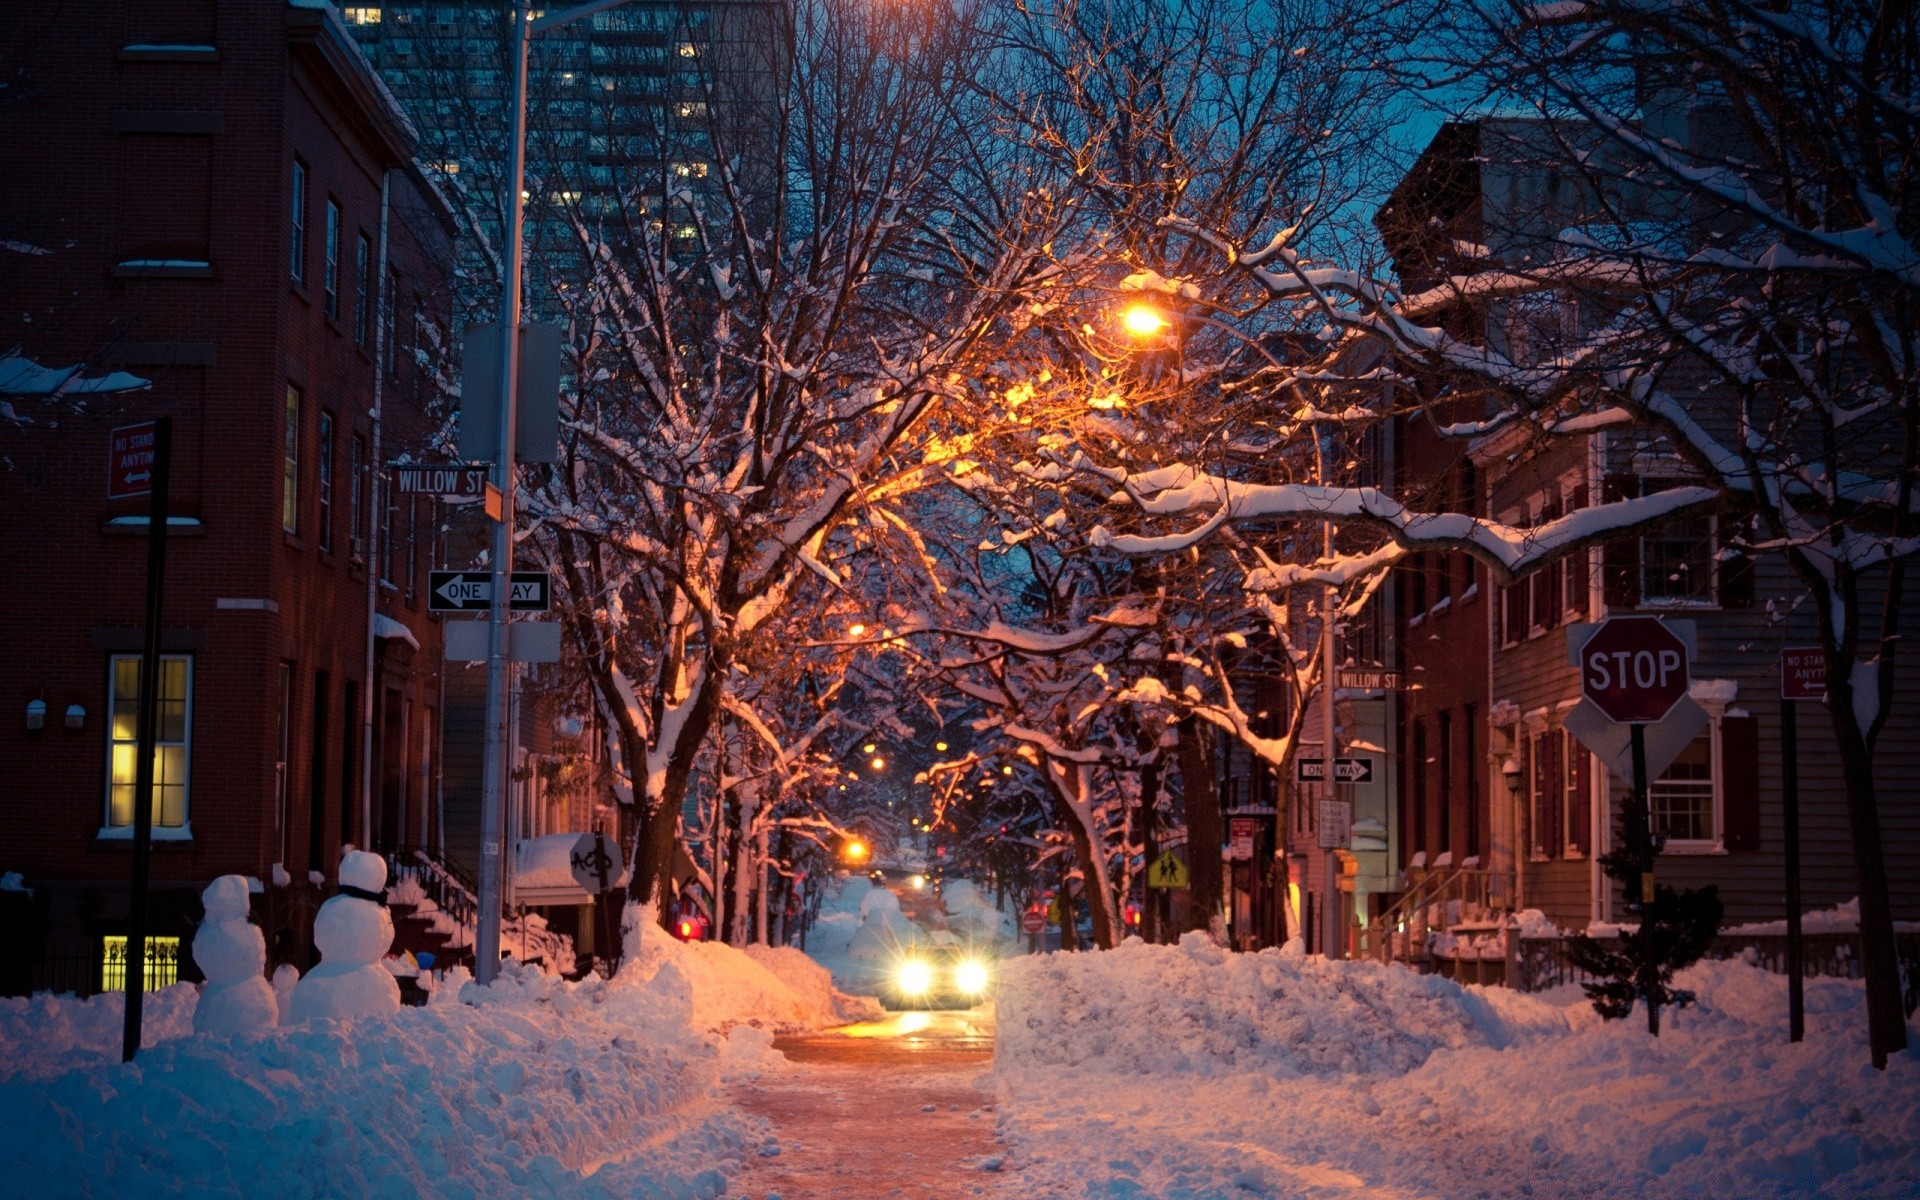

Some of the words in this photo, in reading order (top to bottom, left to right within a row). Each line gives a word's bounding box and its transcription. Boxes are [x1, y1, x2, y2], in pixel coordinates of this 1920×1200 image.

[116, 438, 127, 451] NO
[130, 433, 154, 449] STAND
[120, 451, 155, 468] ANYTIM
[399, 470, 459, 493] WILLOW
[465, 470, 485, 493] ST
[448, 584, 481, 599] ONE
[511, 584, 533, 599] AY
[1787, 655, 1800, 667] NO
[1803, 655, 1825, 667] STAN
[1589, 649, 1681, 691] STOP
[1794, 668, 1824, 680] ANYT
[1341, 673, 1380, 688] WILLOW
[1384, 673, 1397, 689] ST
[1308, 765, 1323, 775] ON
[1339, 766, 1361, 775] WAY
